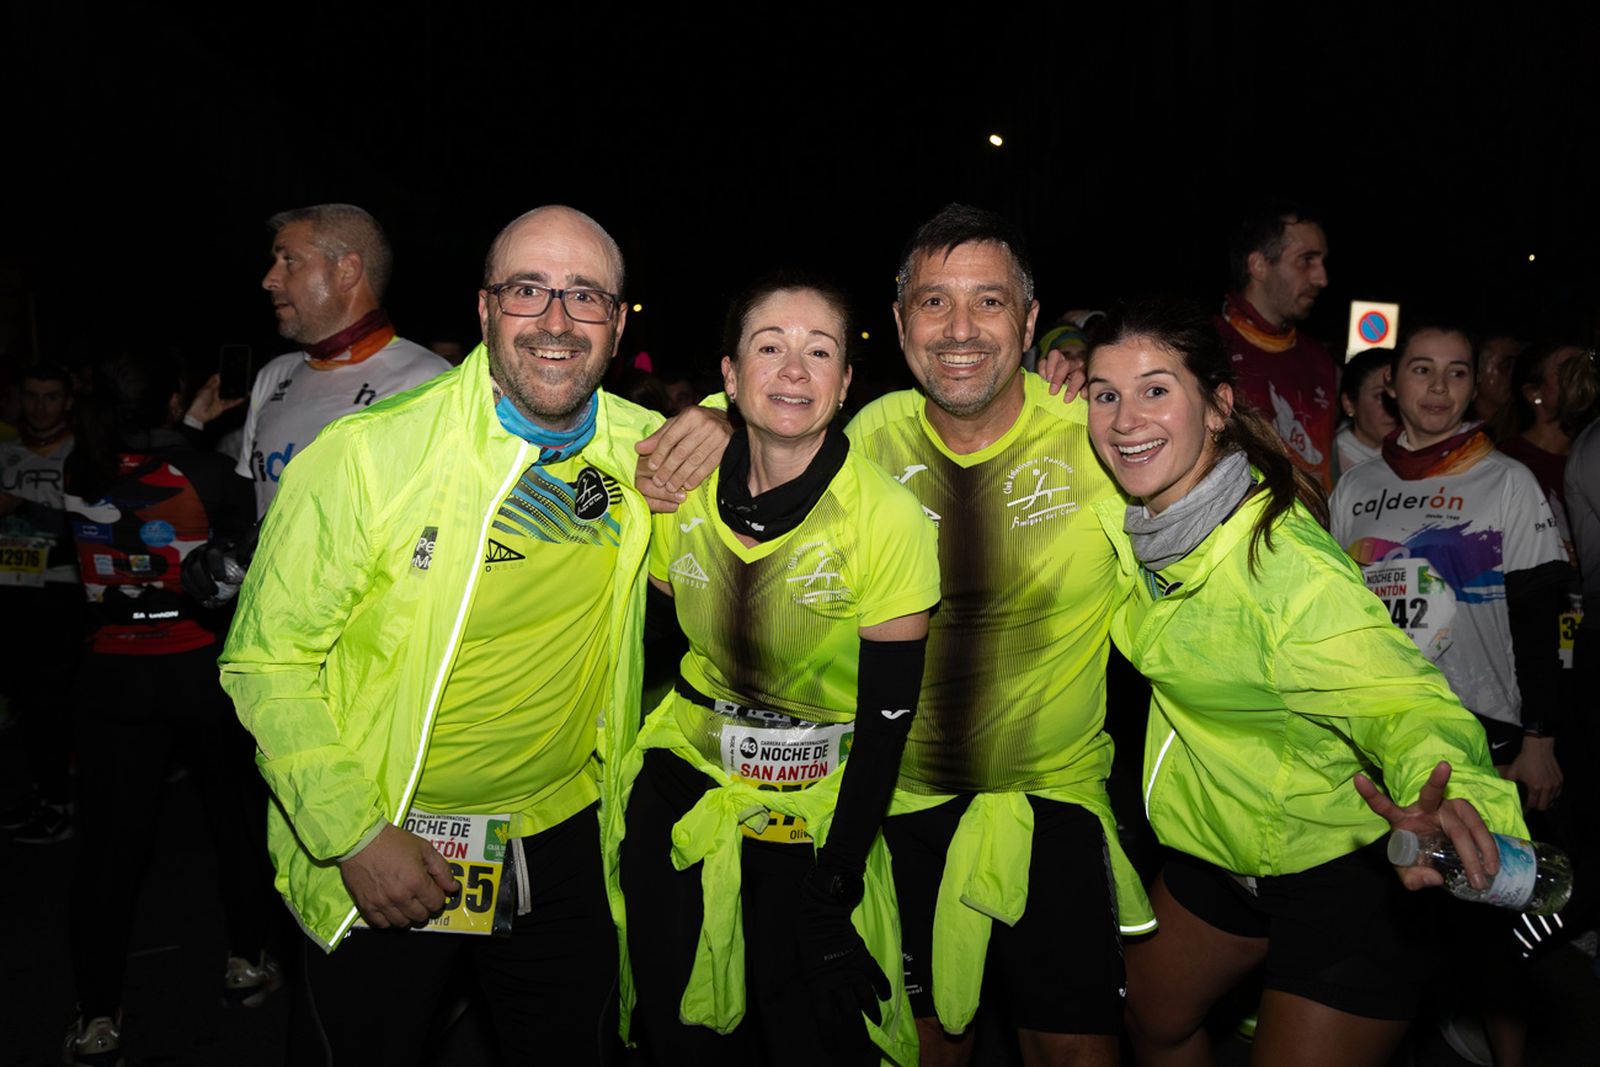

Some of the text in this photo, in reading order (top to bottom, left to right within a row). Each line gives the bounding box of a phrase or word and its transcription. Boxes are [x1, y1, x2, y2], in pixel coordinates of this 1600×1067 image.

[1352, 487, 1464, 520] calderón
[1367, 572, 1407, 584] NOCHE DE
[741, 742, 829, 762] 43 NOCHE DE
[741, 760, 828, 781] SAN ANTÓN
[405, 818, 471, 838] OCHE DE
[431, 837, 469, 859] TÓN
